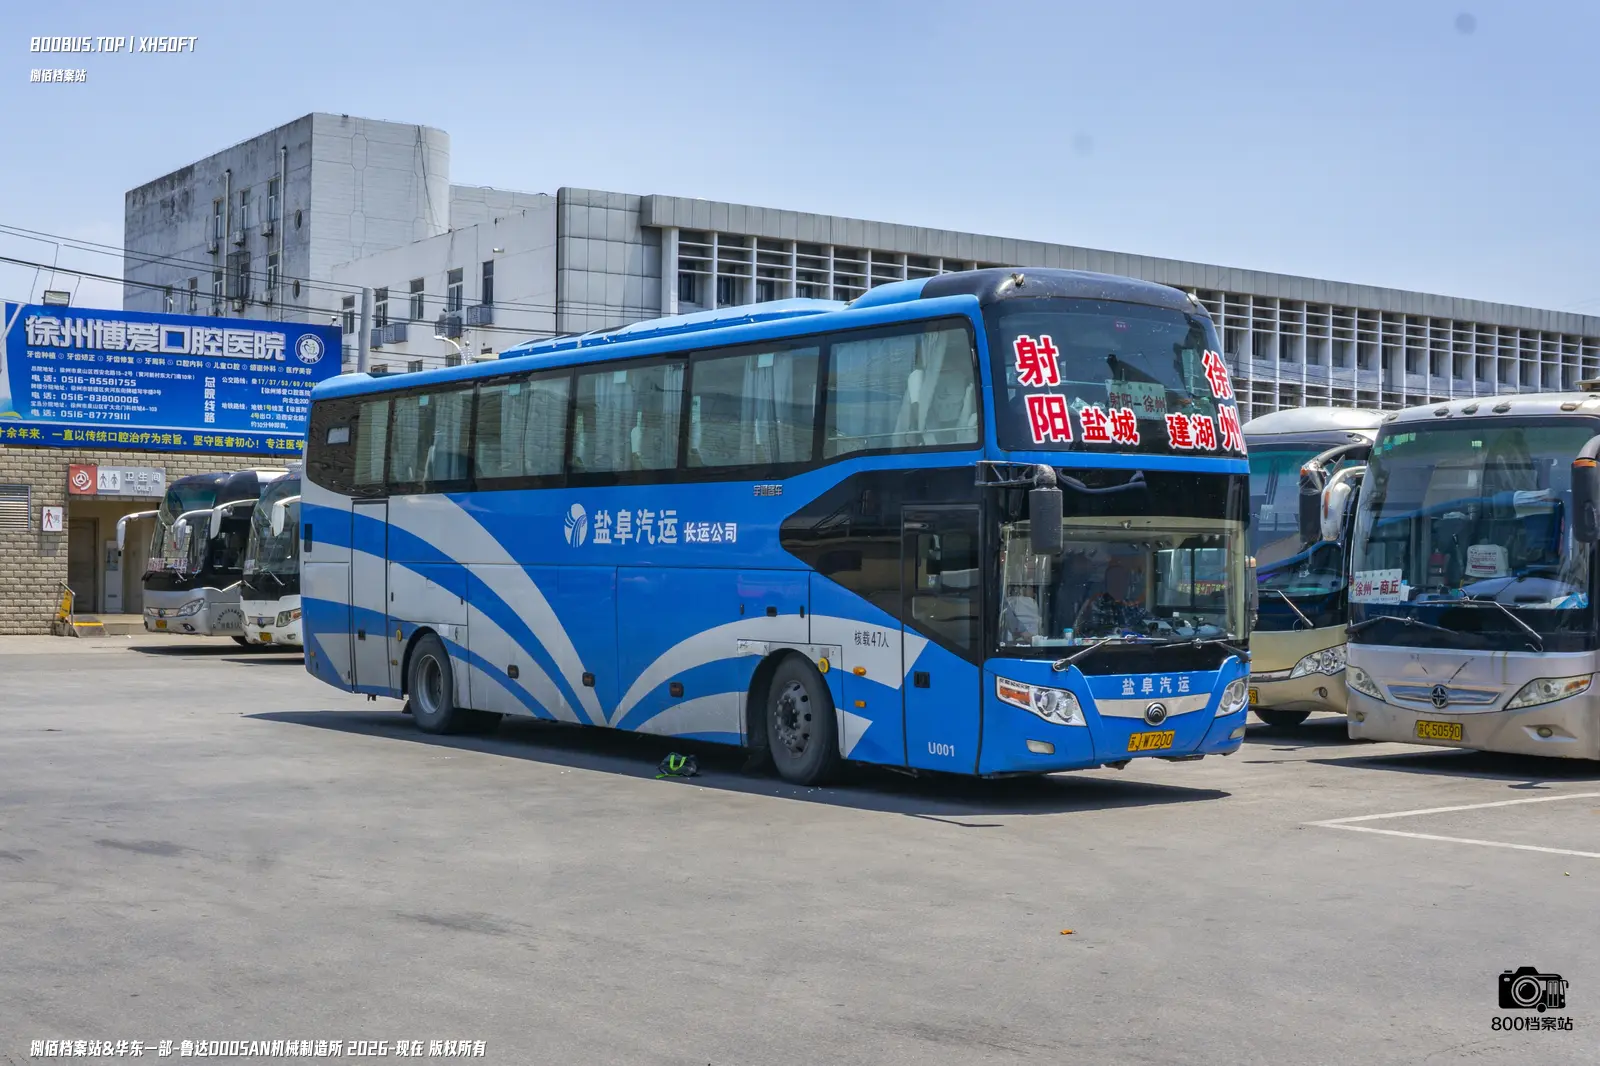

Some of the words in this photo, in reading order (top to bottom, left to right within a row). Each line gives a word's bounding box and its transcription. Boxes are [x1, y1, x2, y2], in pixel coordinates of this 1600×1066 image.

[25, 314, 286, 362] 徐州博爱口腔医院
[26, 350, 57, 360] 牙齿种植
[66, 352, 96, 362] 牙齿矫正
[106, 355, 135, 364] 牙齿修复
[144, 357, 166, 366] 牙周科
[175, 359, 204, 368] 口腔内科
[213, 361, 241, 371] 儿童口腔
[285, 366, 313, 376] 医疗美容
[61, 375, 137, 387] 0516-85581755
[1014, 335, 1073, 443] 射阳
[61, 392, 139, 404] 0516-83800006
[204, 376, 216, 423] 总院线路
[1202, 350, 1247, 455] 徐州
[60, 410, 130, 420] 0516-87779111
[1081, 407, 1140, 445] 盐城
[1165, 412, 1217, 450] 建湖
[124, 471, 161, 483] 卫生间
[593, 508, 678, 545] 盐阜汽运
[683, 522, 737, 543] 长运公司
[854, 630, 889, 648] 核载47人
[1121, 676, 1190, 696] 盐阜汽运
[928, 741, 955, 757] U001
